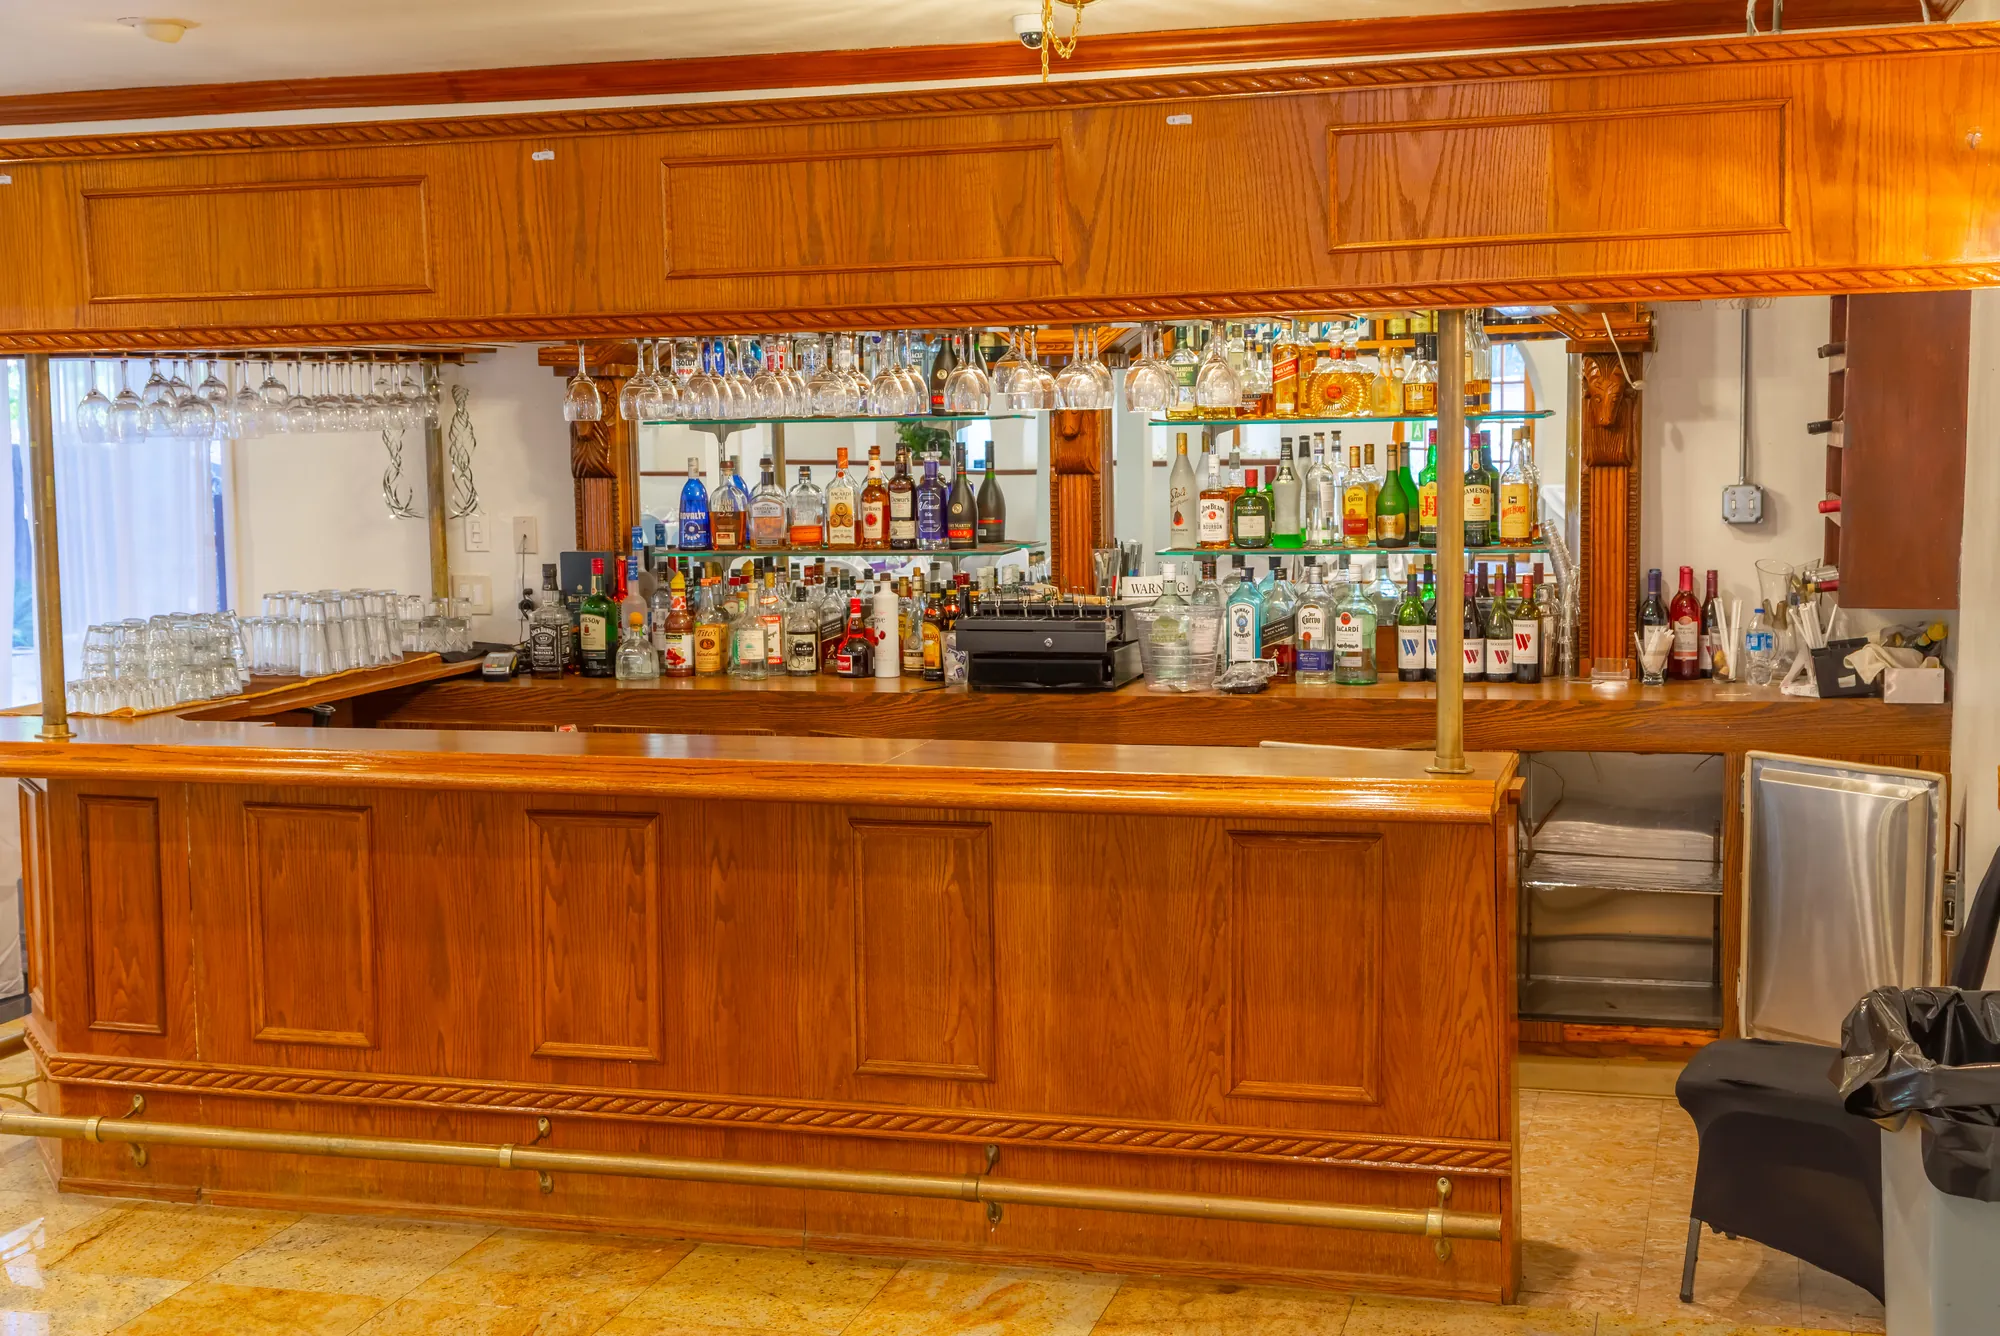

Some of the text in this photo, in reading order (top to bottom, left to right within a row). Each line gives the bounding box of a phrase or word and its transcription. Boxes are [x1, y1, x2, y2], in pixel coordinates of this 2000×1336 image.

[1413, 424, 1422, 438] A
[1201, 503, 1225, 514] JIM BEAM
[1131, 583, 1189, 594] WARNG:
[1302, 615, 1321, 625] Cuervo
[531, 628, 540, 637] JACK
[697, 629, 717, 637] Tito's
[1233, 630, 1251, 638] SAPPHIRE
[1263, 625, 1288, 637] BLACK LABEL
